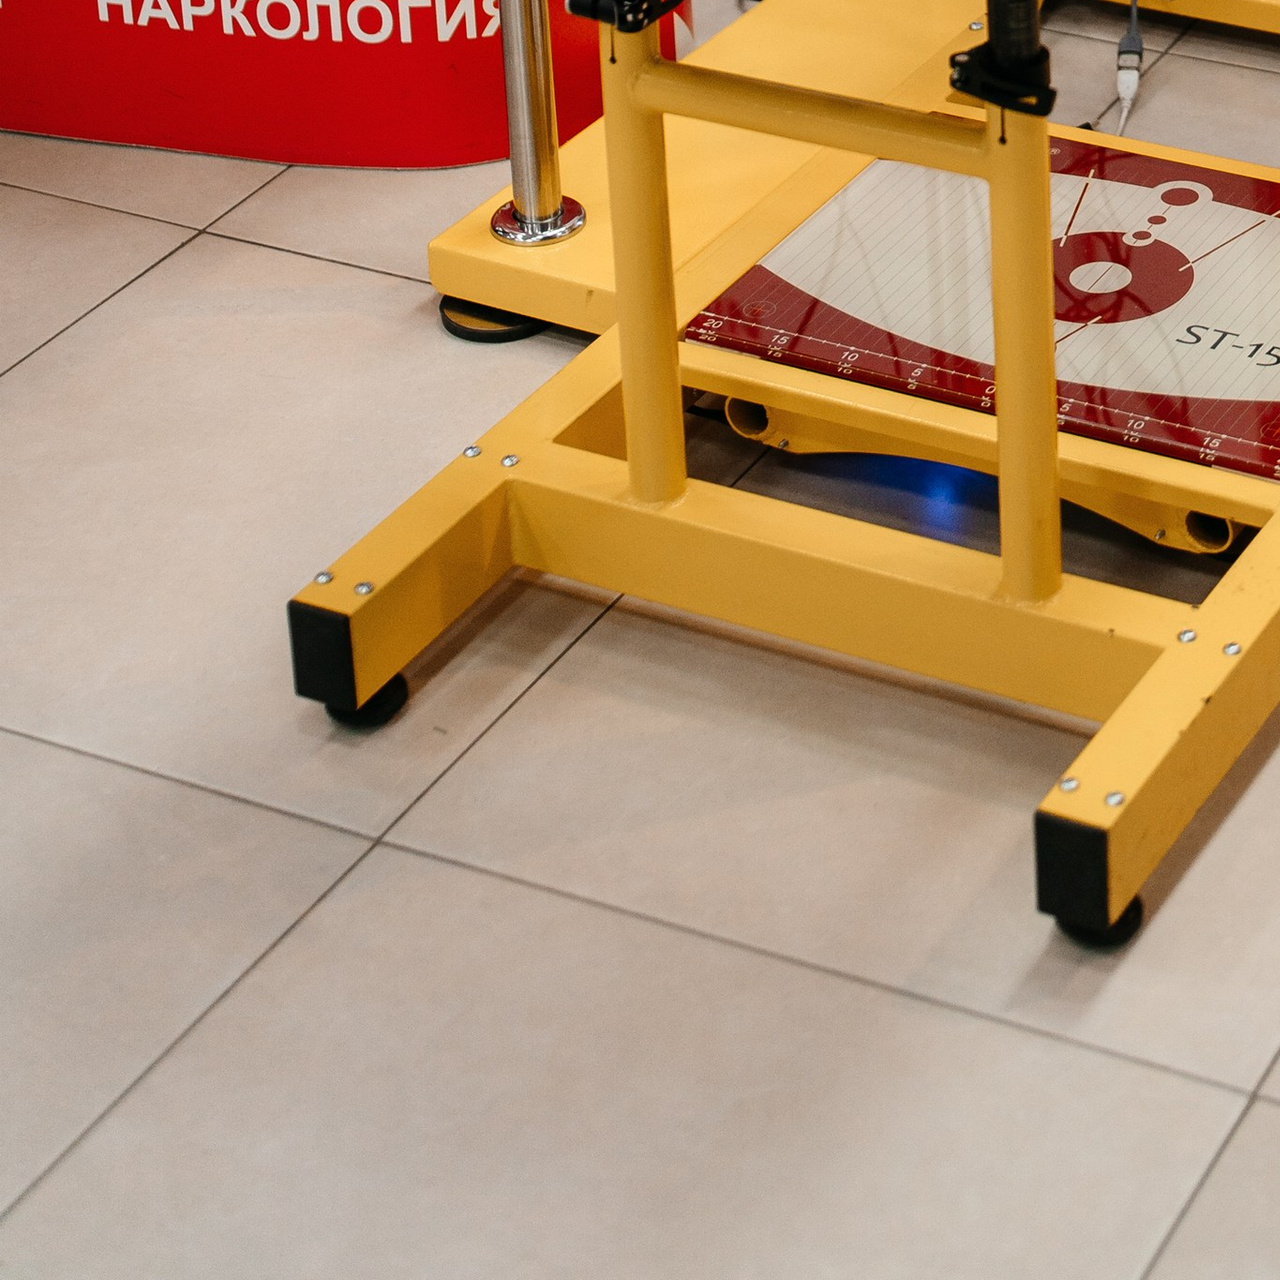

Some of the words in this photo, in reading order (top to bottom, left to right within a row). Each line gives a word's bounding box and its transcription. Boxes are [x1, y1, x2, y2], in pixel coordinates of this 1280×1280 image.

[702, 318, 723, 329] 20
[771, 334, 790, 345] 15
[841, 351, 859, 361] 10
[911, 368, 924, 377] 5
[1126, 419, 1145, 430] 10
[1202, 436, 1222, 448] 15
